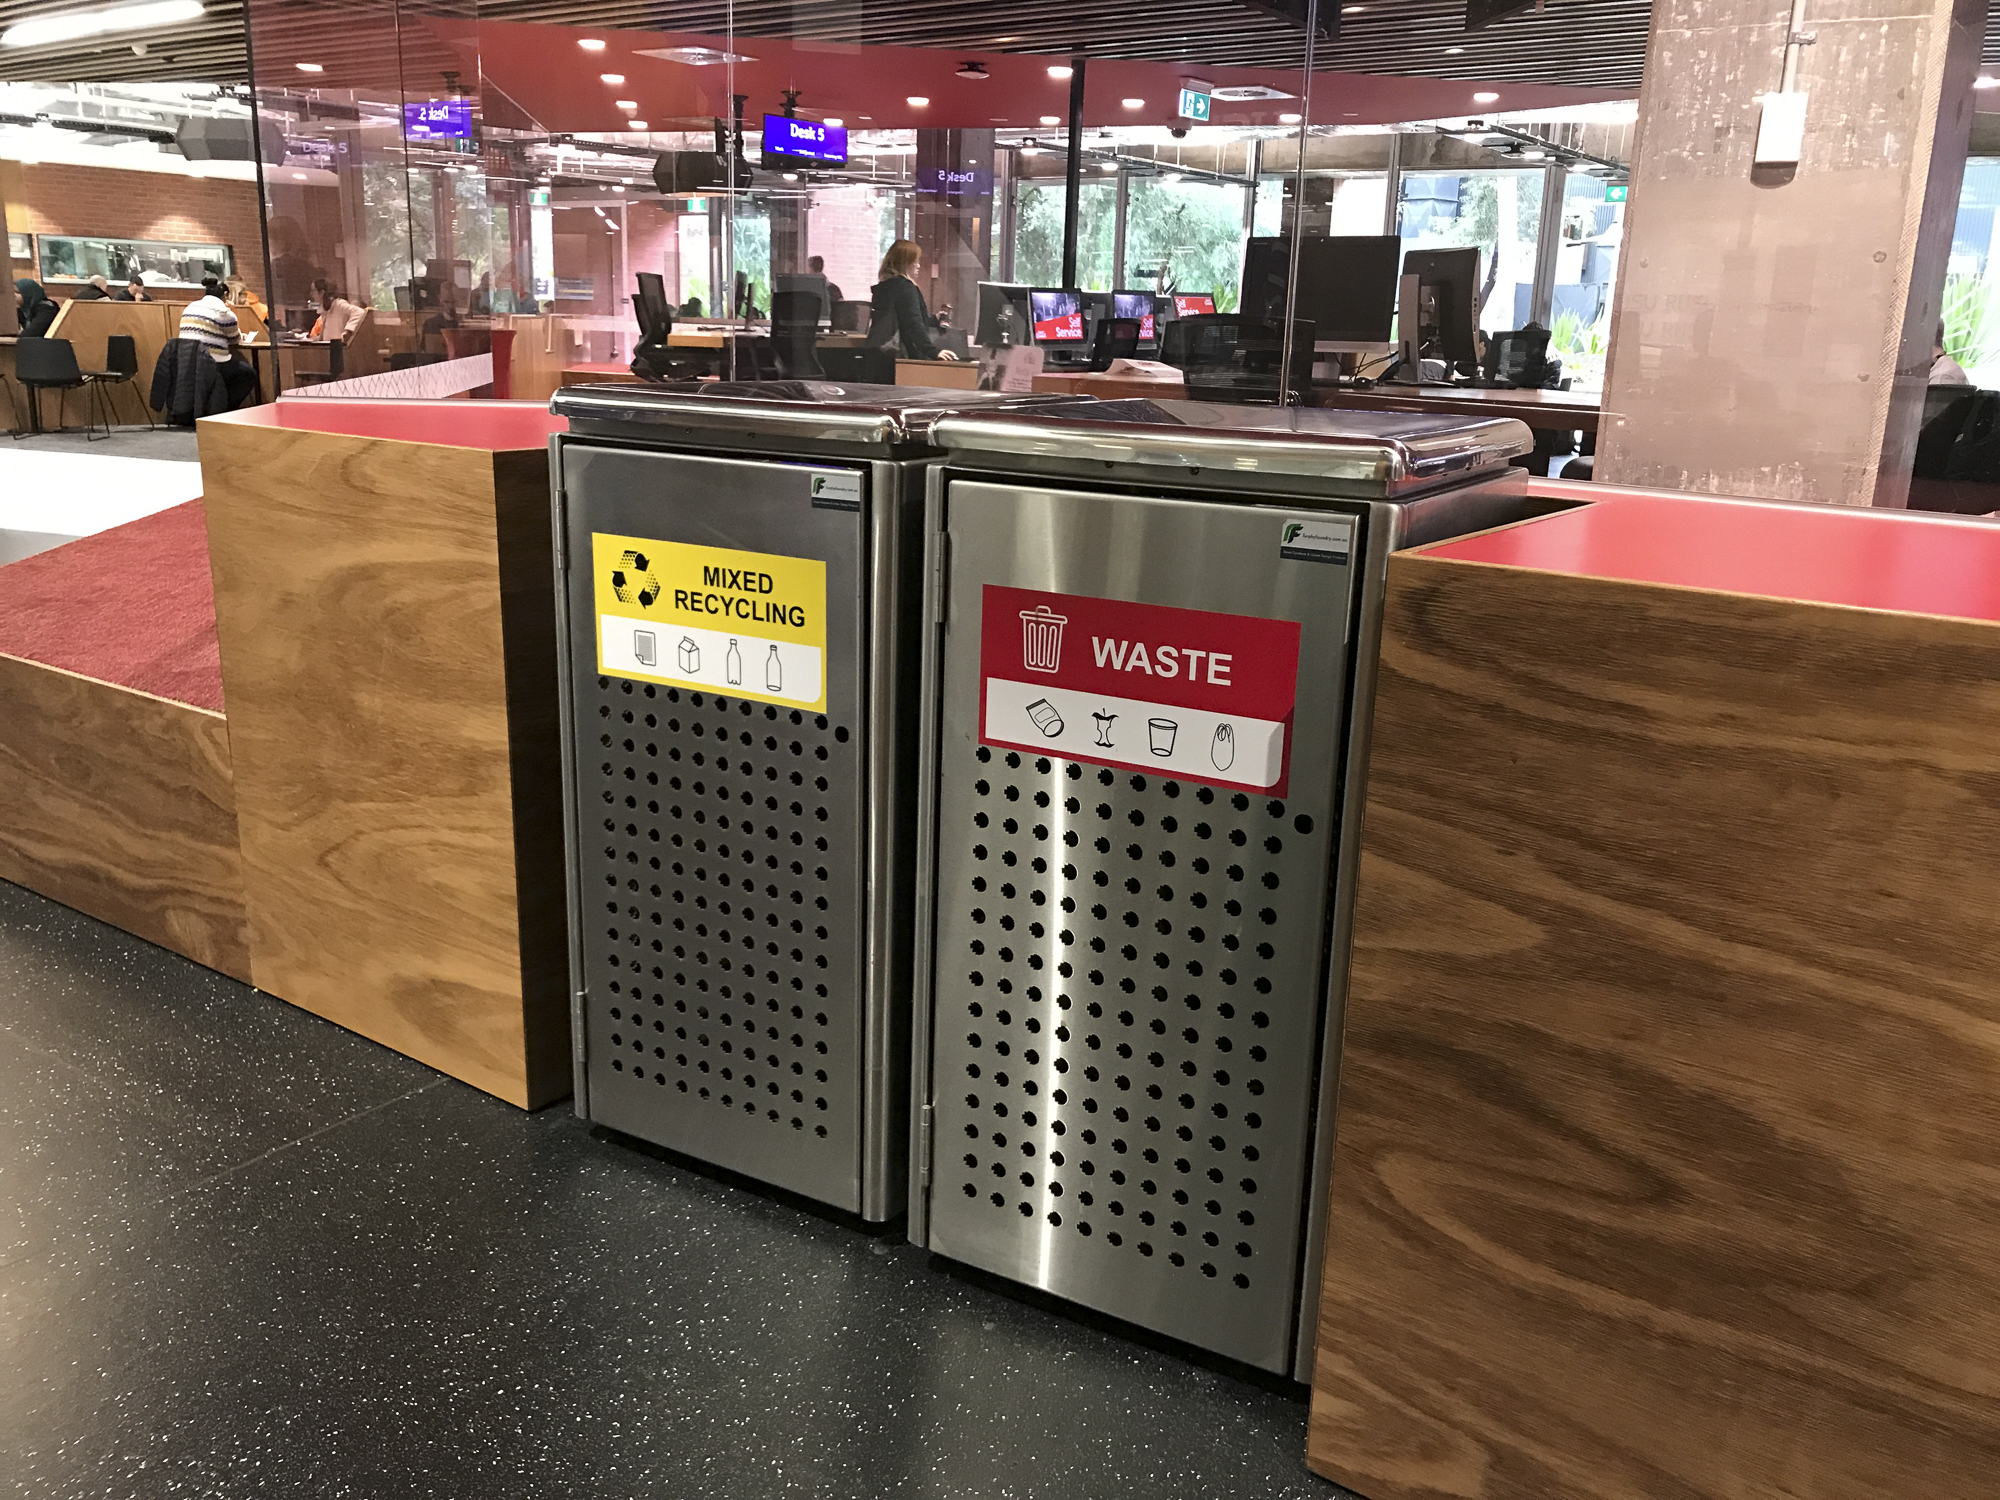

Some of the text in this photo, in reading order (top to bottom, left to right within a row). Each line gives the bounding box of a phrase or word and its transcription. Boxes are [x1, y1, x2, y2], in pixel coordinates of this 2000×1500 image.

[790, 123, 825, 142] Desk 5
[338, 142, 348, 154] 5
[1175, 298, 1187, 308] Self
[1068, 316, 1081, 328] Self
[1143, 317, 1154, 329] Self
[1055, 326, 1083, 338] Service
[702, 565, 774, 595] MIXED
[674, 589, 806, 628] RECYCLING
[1091, 636, 1233, 686] WASTE
